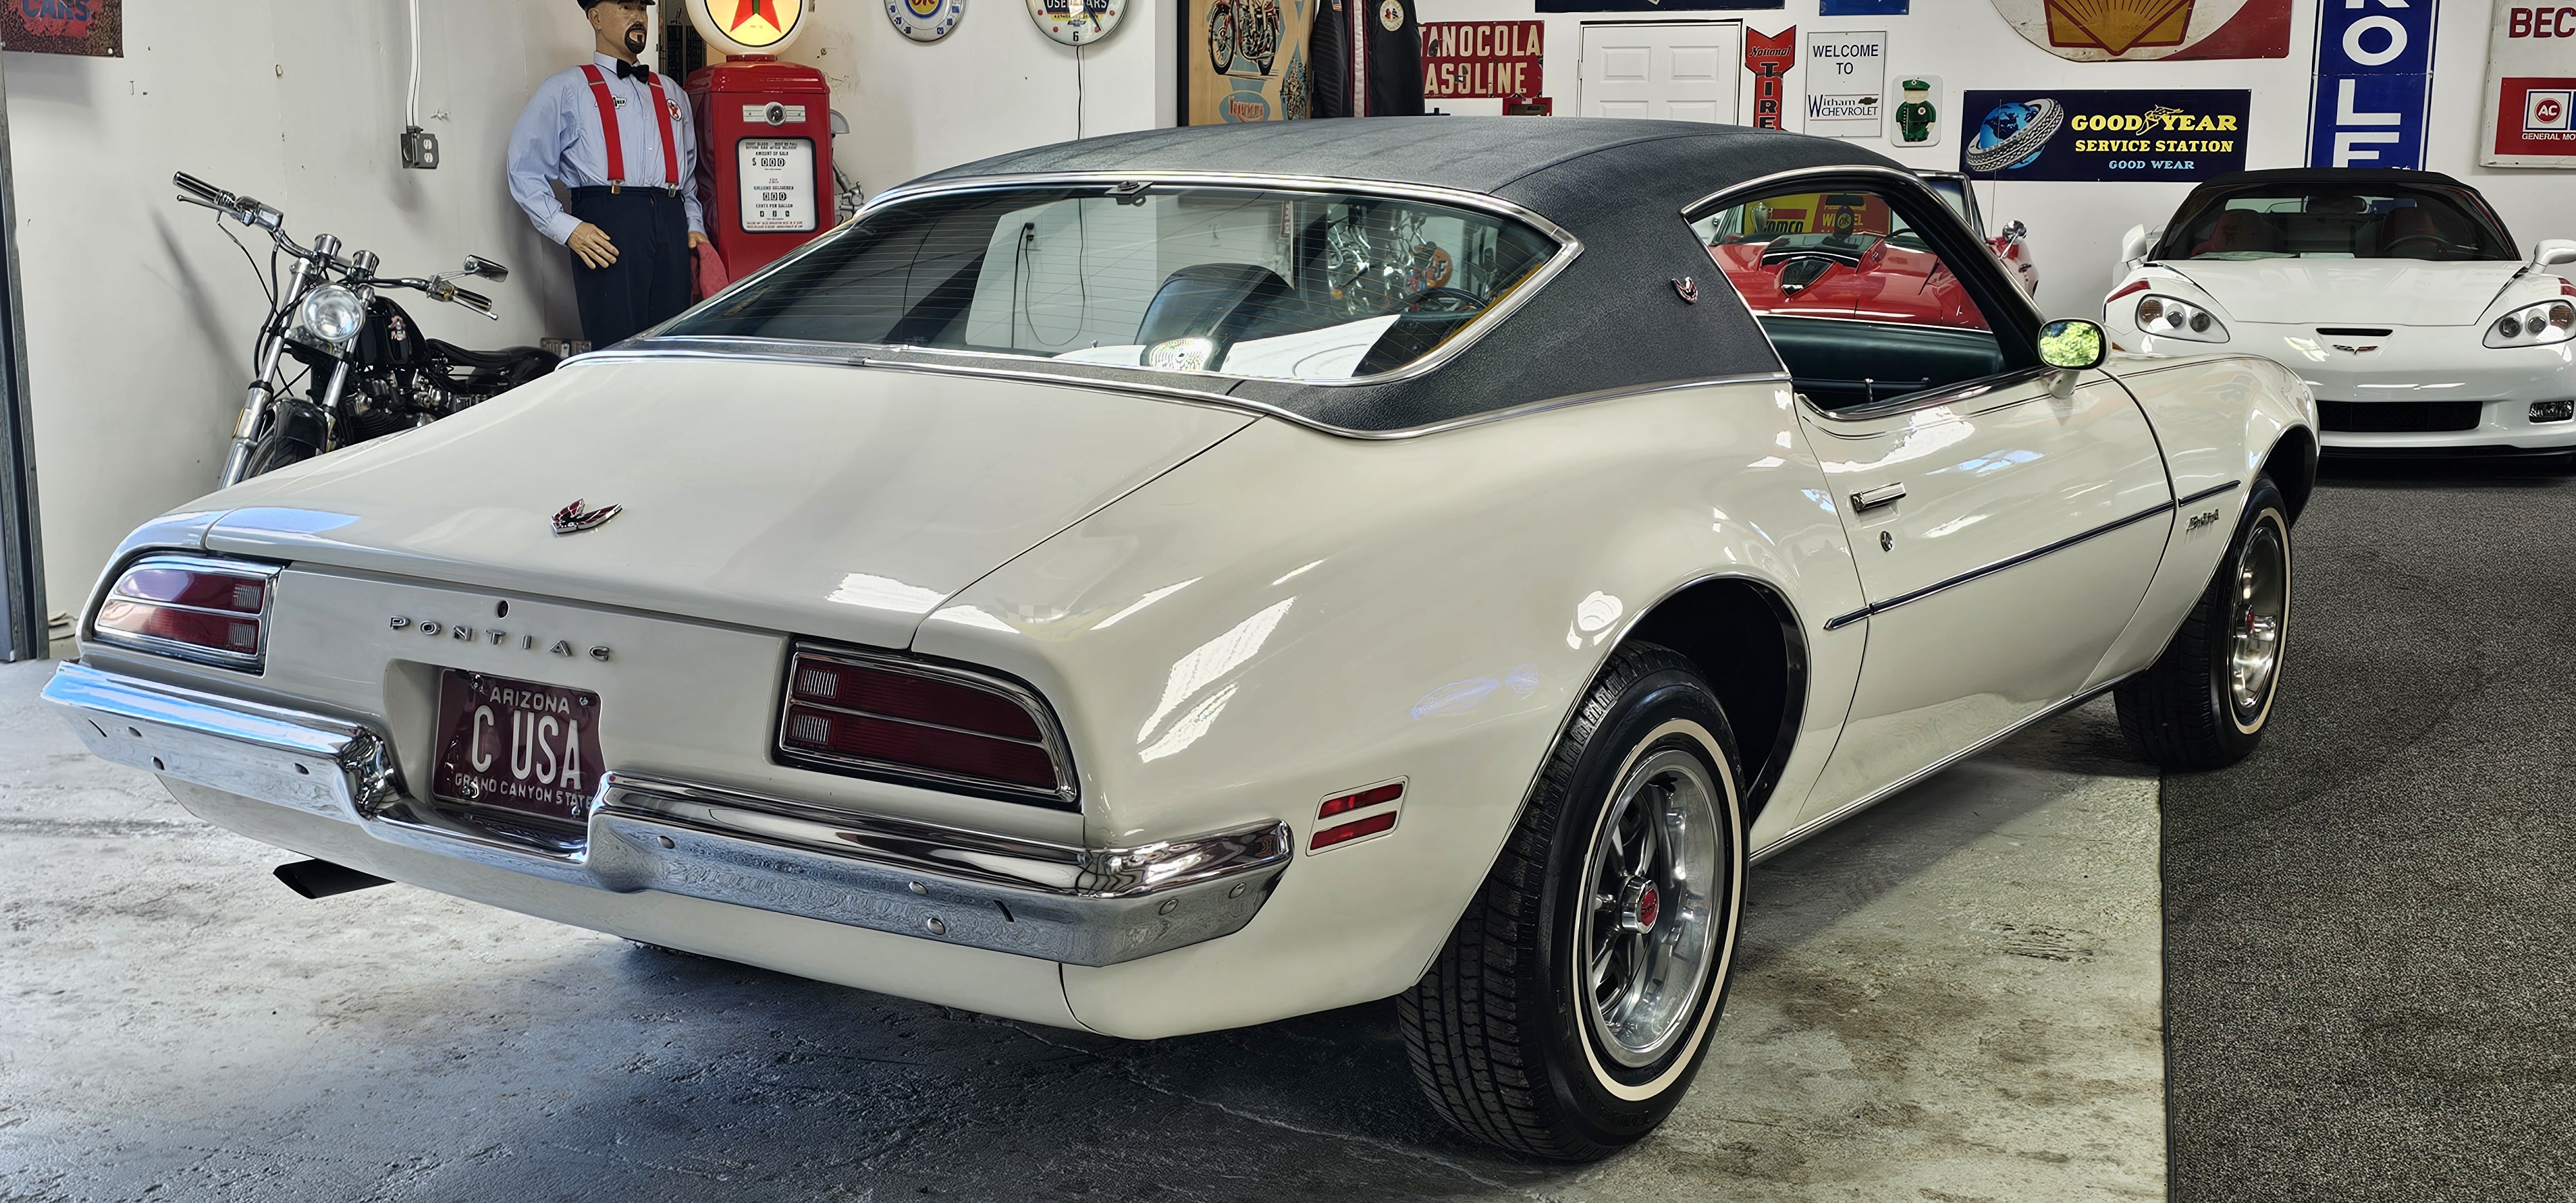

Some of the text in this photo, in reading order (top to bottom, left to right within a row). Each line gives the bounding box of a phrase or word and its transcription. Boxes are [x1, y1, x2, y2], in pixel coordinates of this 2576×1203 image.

[2509, 7, 2576, 38] BEC
[1073, 31, 1079, 42] 6
[1748, 45, 1792, 57] National
[1813, 44, 1879, 57] WELCOME
[1836, 62, 1853, 75] TO
[1821, 106, 1879, 117] CHEVROLET
[2537, 104, 2558, 117] AC
[2522, 132, 2560, 140] GENERAL
[2075, 140, 2234, 152] SERVICE STATION
[2108, 160, 2195, 169] GOOD WEAR
[390, 615, 611, 662] PONTIAC
[489, 686, 570, 715] ARIZONA
[471, 705, 582, 790] C USA
[455, 772, 592, 809] GRAND CANYON STATE
